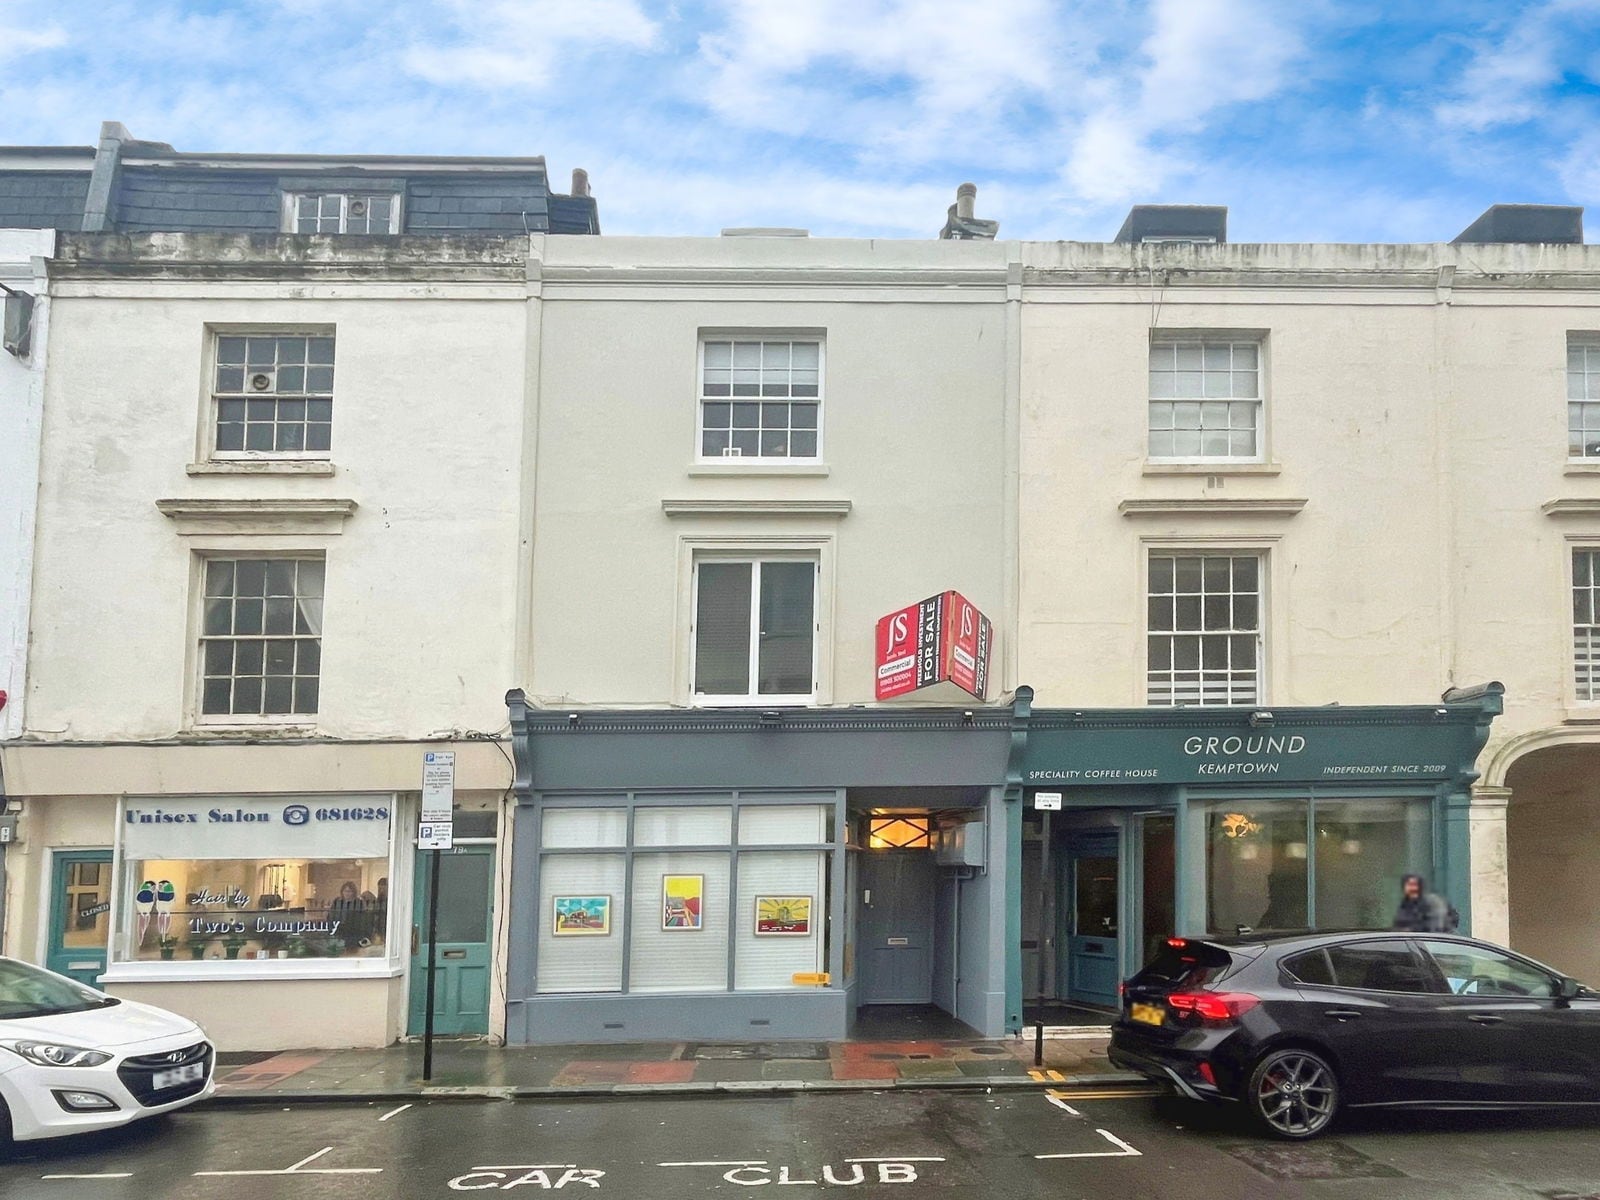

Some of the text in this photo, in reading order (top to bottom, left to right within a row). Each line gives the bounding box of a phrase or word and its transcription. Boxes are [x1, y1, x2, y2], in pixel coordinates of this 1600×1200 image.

[924, 601, 936, 681] FOR SALE
[880, 658, 911, 675] Commercial
[1183, 735, 1306, 755] GROUND
[1029, 768, 1158, 779] SPECIALITY COFFEE HOUSE
[1198, 763, 1280, 775] KEMPTOWN
[1323, 765, 1446, 774] INDEPENDENT SINCE 2009
[126, 807, 389, 824] Unisex Salon 681628
[191, 888, 250, 909] Hair by
[189, 916, 341, 936] Two's Company
[447, 1163, 918, 1191] CAR CLUB
